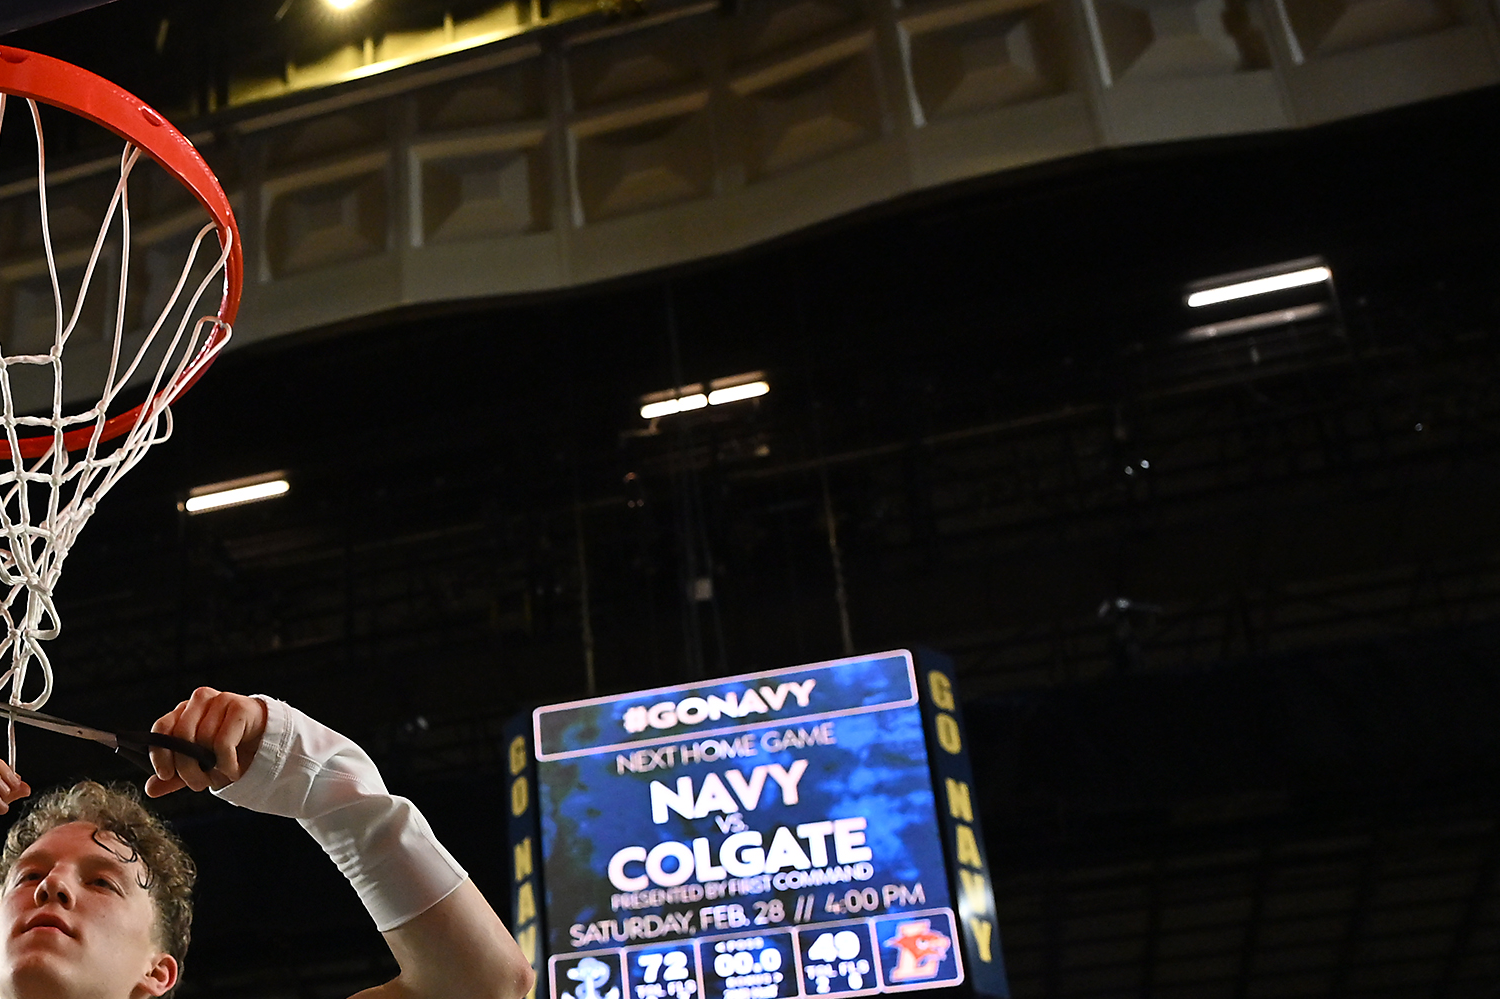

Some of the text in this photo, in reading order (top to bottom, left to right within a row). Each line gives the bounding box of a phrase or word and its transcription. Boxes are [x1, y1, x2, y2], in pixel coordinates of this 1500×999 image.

[623, 679, 816, 733] #GONAVY
[928, 670, 962, 754] GO
[616, 722, 836, 775] NEXT HOME GAME
[650, 759, 808, 824] NAVY
[608, 817, 872, 892] COLGATE
[945, 777, 992, 963] NAVY
[569, 910, 697, 947] SATURDAY,
[699, 903, 750, 932] FEB.
[752, 898, 786, 926] 28
[881, 882, 926, 908] PM
[610, 883, 704, 912] PRESENTED
[704, 880, 728, 901] BY
[772, 861, 874, 891] COMMAND
[637, 951, 689, 983] 72
[714, 948, 782, 978] 00.0
